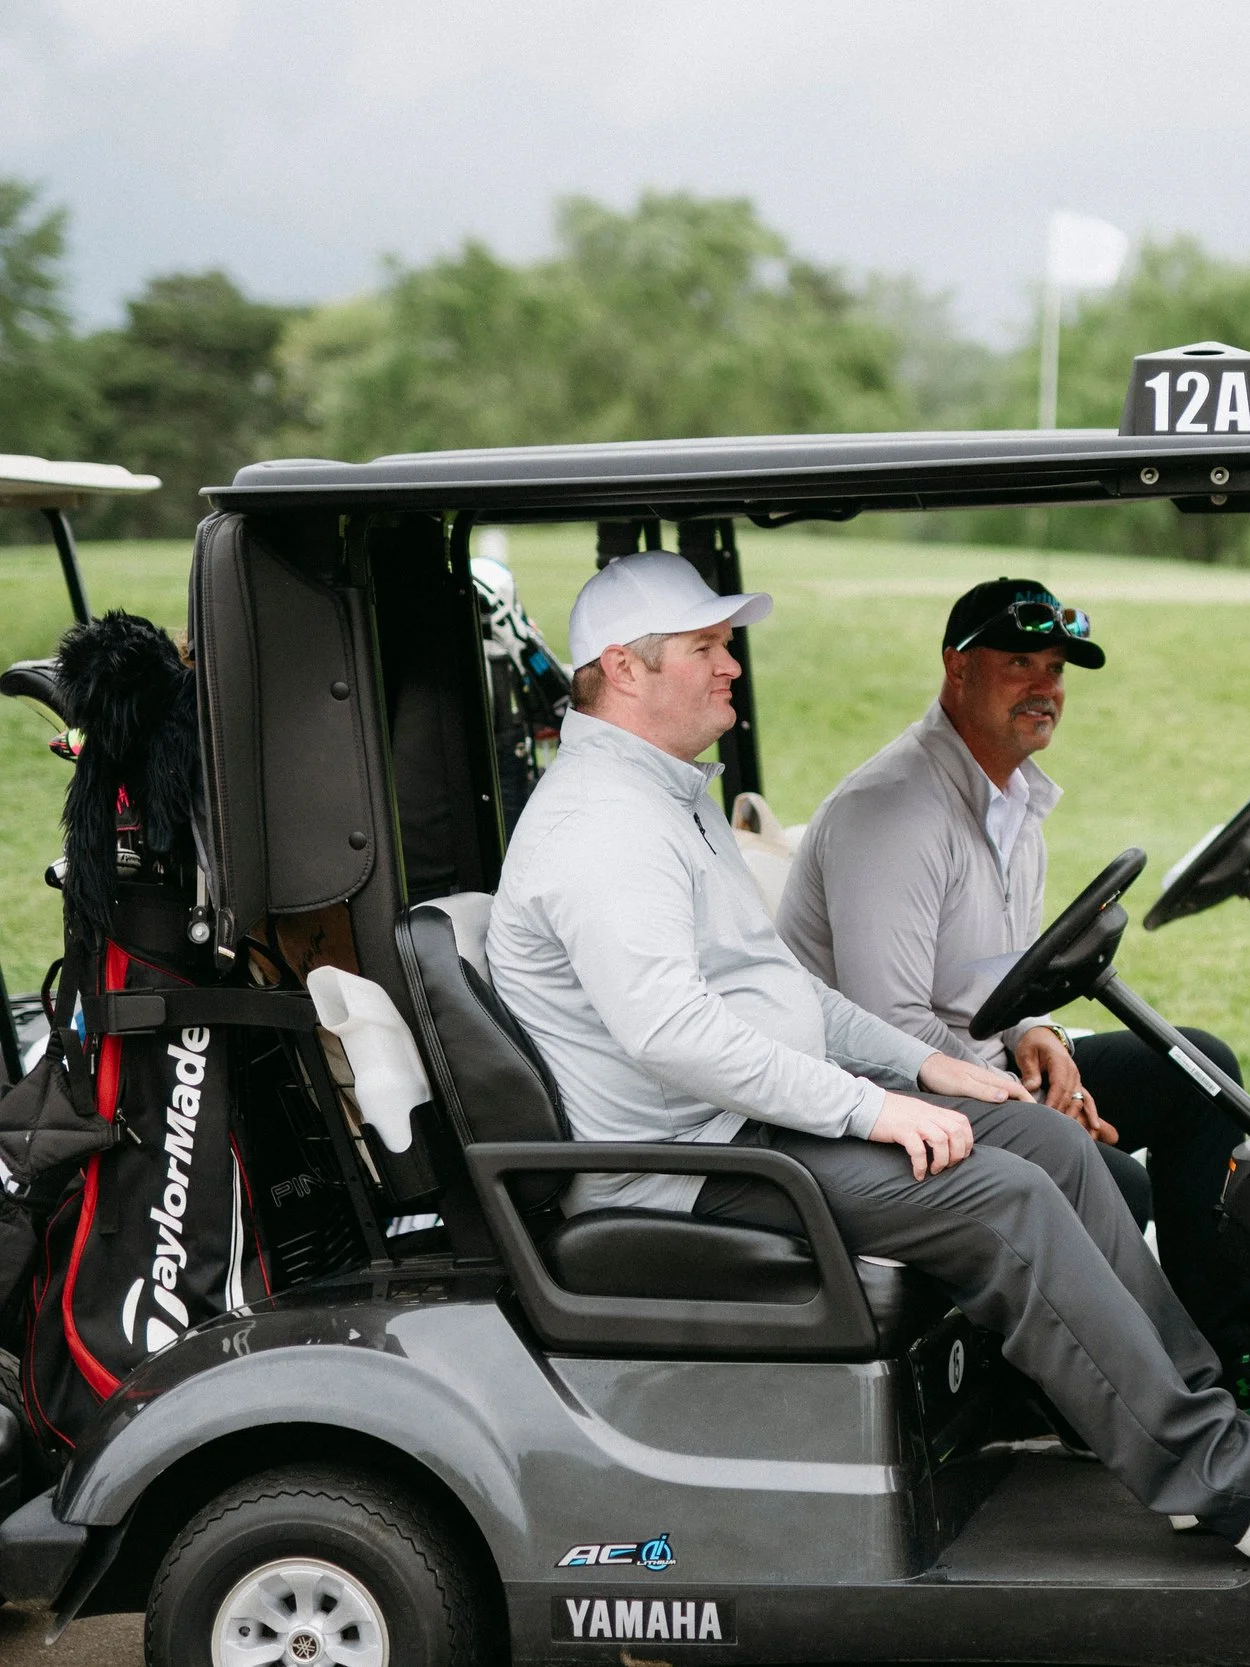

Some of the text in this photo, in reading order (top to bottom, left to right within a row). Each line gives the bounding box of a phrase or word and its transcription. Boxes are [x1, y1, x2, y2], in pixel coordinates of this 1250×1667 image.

[122, 1026, 210, 1353] TaylorMade
[270, 1173, 326, 1207] PIN
[566, 1599, 723, 1640] YAMAHA
